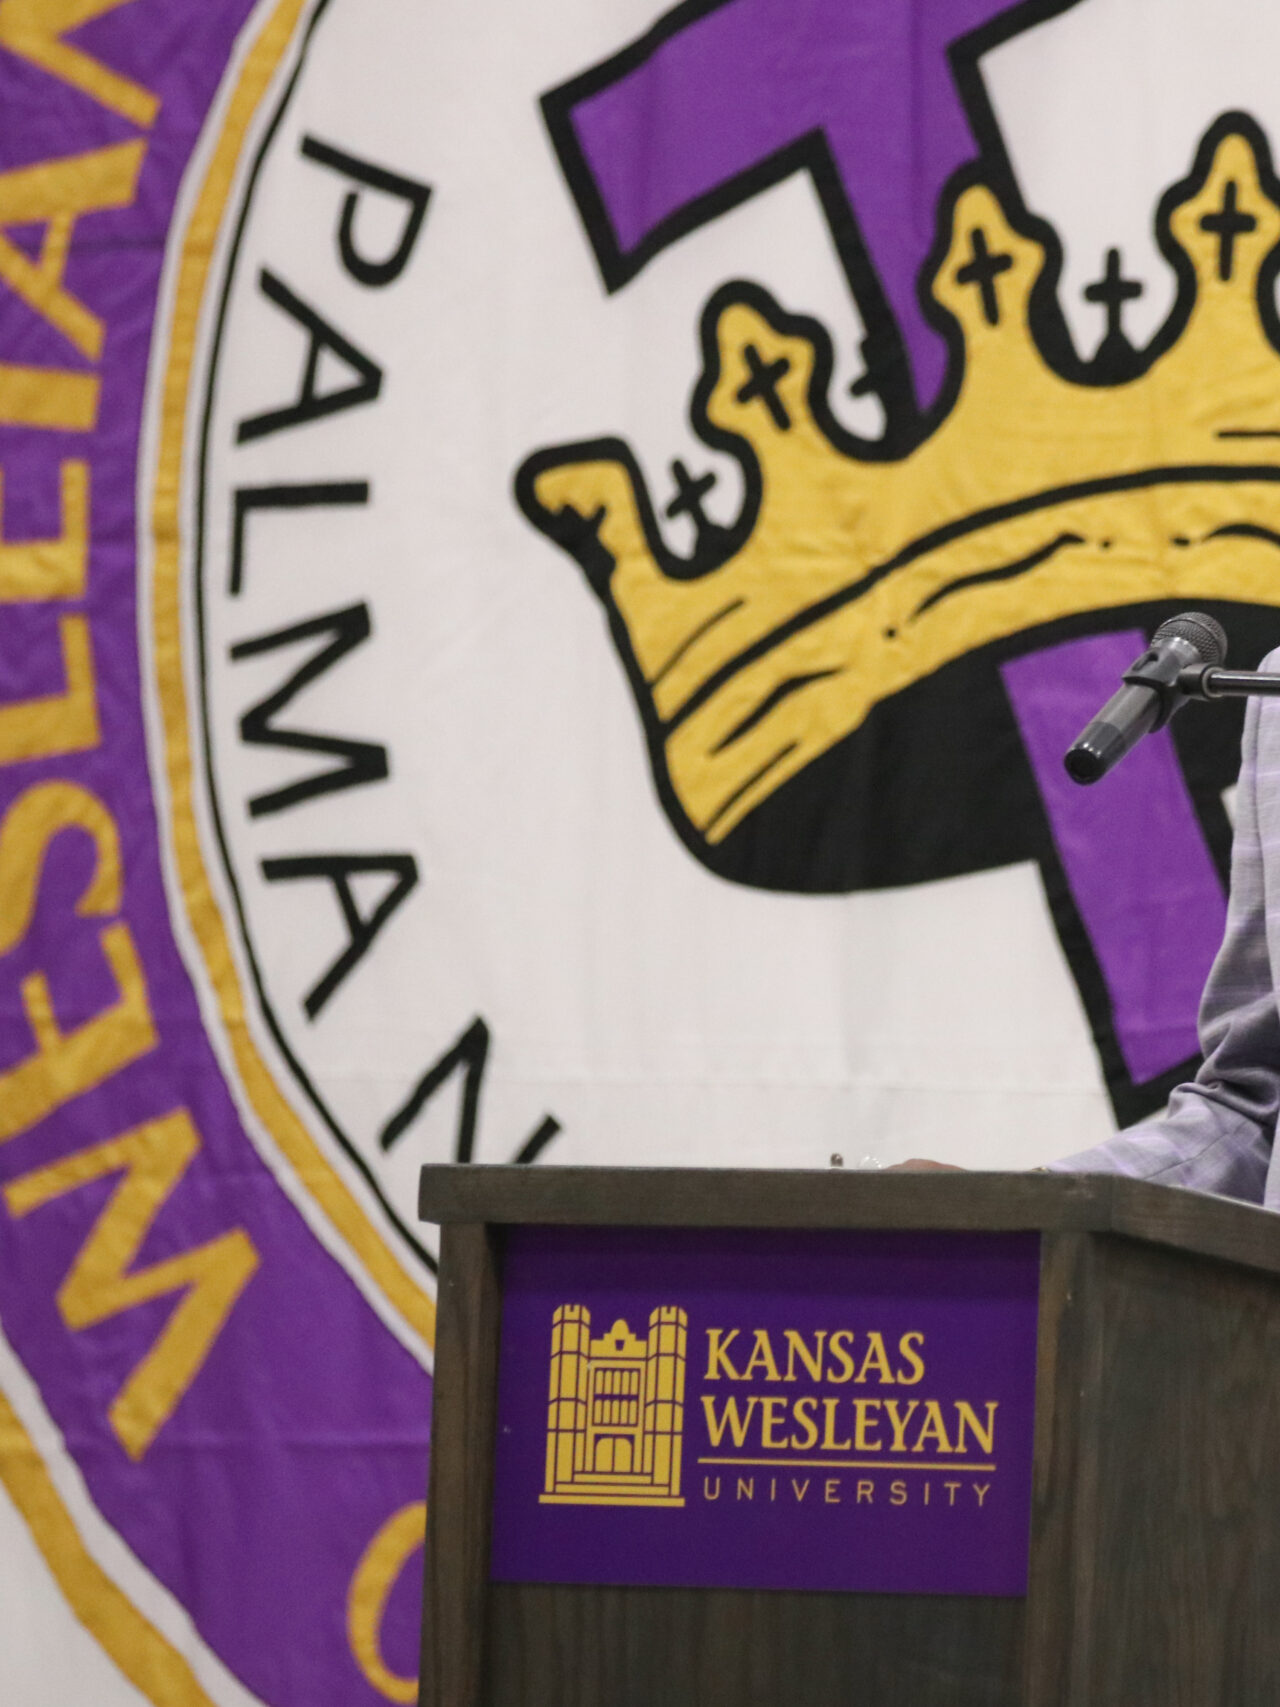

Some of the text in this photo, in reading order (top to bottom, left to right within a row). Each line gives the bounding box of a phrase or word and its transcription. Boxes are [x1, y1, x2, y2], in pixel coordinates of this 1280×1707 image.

[704, 1328, 925, 1385] KANSAS
[700, 1395, 998, 1454] WESLEYAN
[704, 1475, 992, 1507] UNIVERSITY
